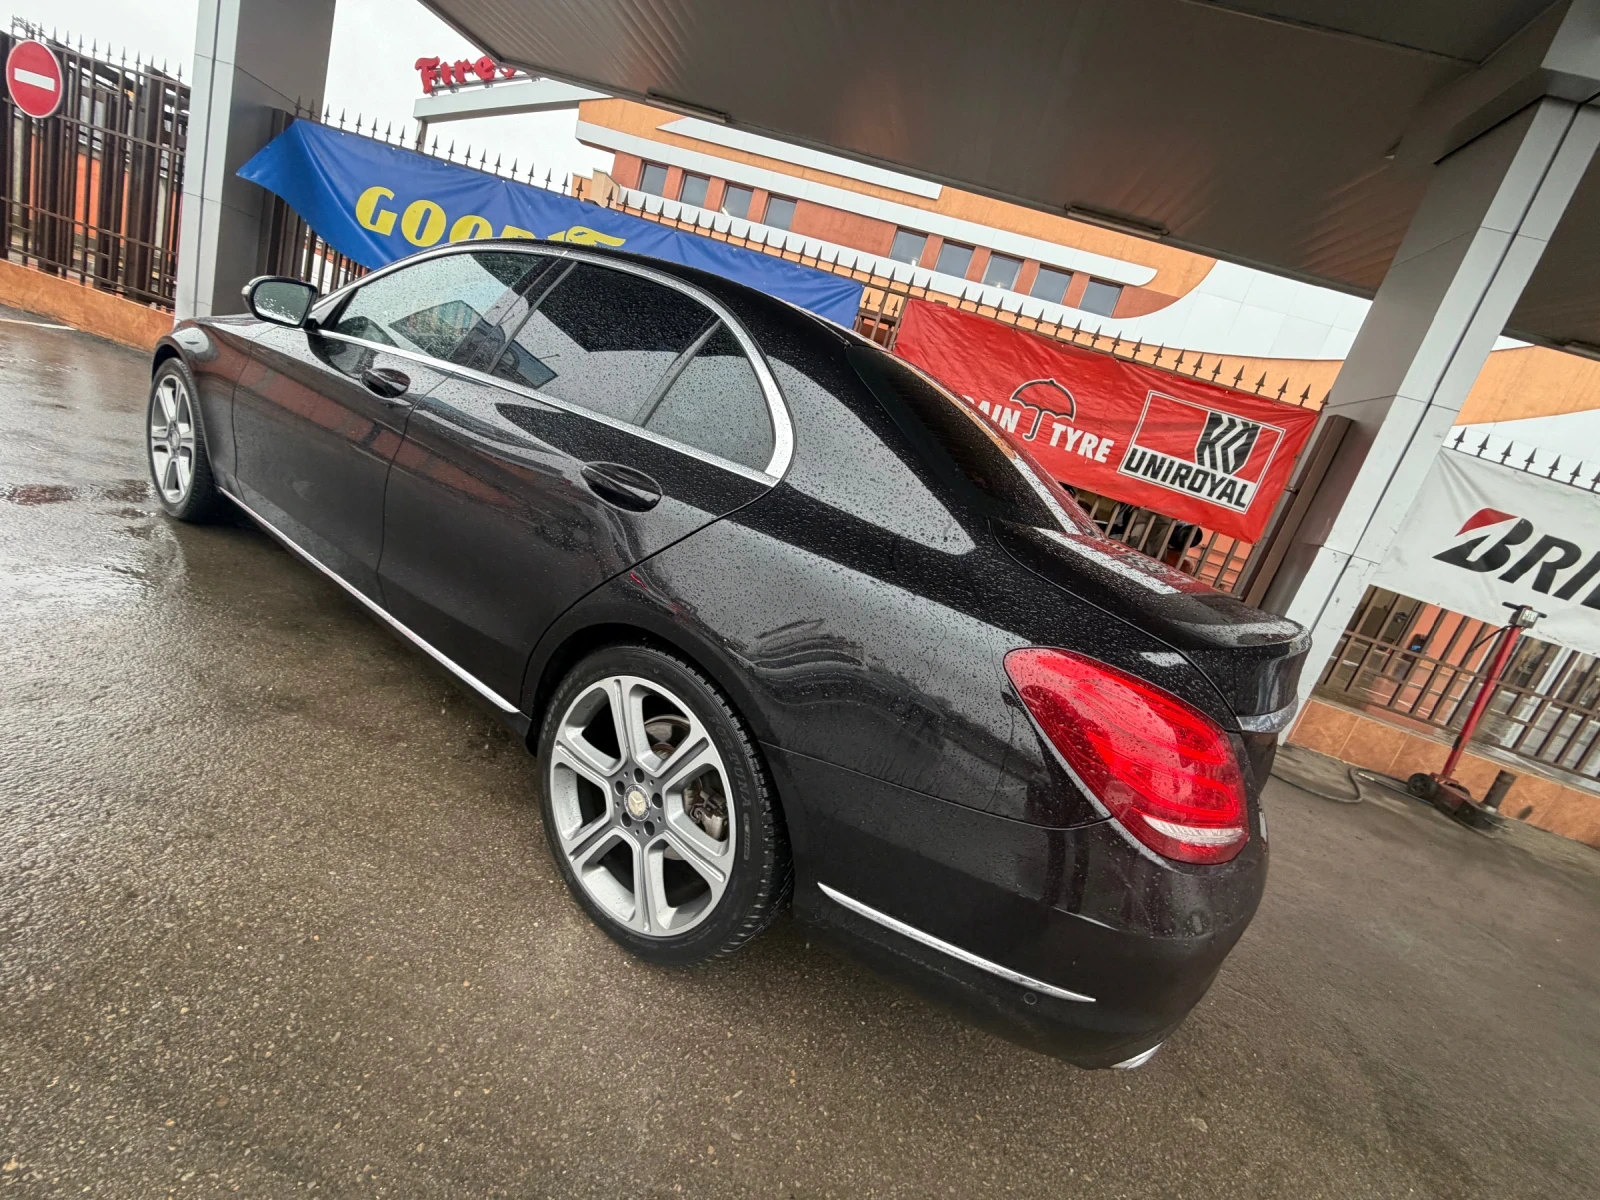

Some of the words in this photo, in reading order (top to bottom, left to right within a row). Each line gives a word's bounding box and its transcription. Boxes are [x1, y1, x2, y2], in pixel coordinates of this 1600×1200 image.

[1049, 422, 1115, 463] TYRE
[1124, 447, 1249, 509] UNIROYAL
[1431, 508, 1600, 611] BRI
[708, 714, 751, 808] FORTUNA
